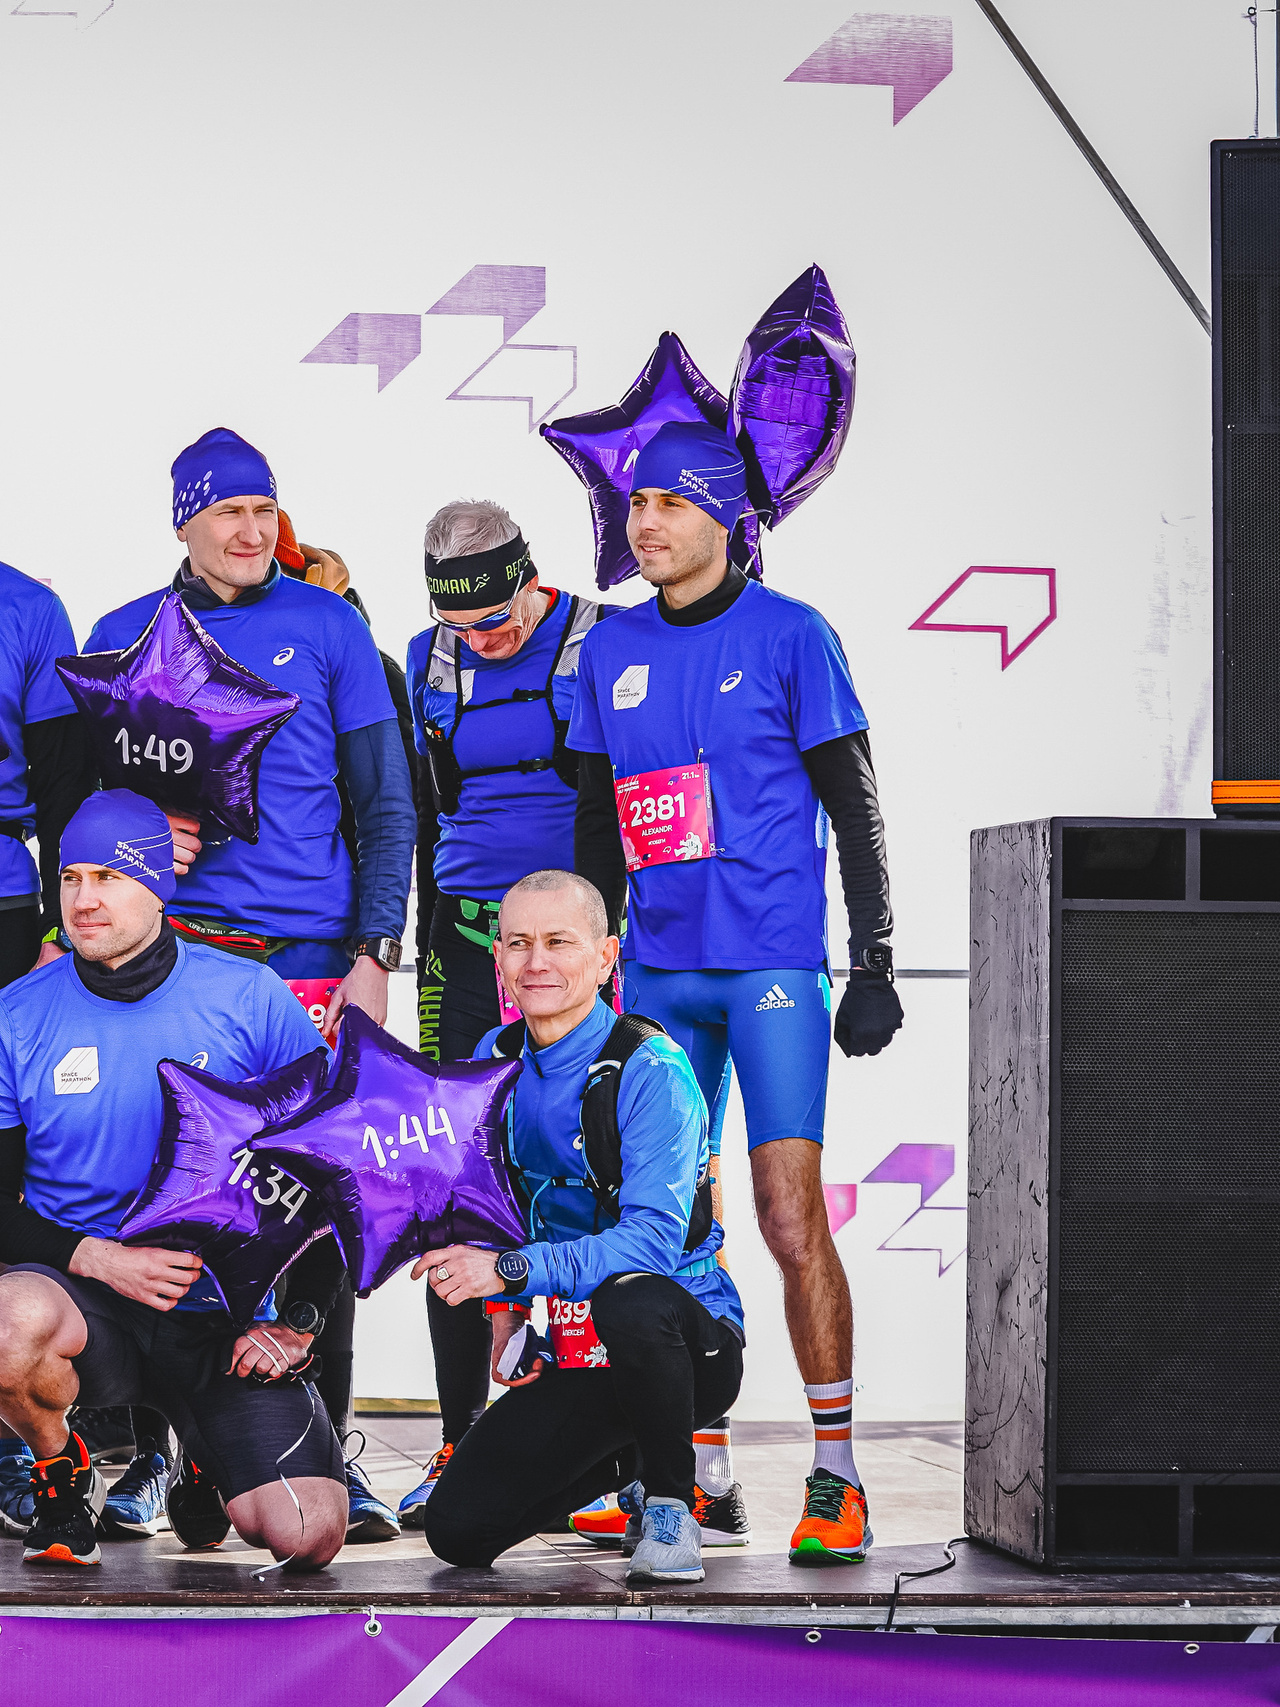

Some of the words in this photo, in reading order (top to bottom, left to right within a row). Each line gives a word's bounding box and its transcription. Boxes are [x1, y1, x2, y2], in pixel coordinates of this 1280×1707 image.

[678, 475, 723, 510] MARATHON
[681, 469, 710, 490] SPACE
[114, 727, 194, 774] 1:49
[629, 792, 686, 827] 2381
[642, 824, 673, 837] ALEXANDR
[114, 848, 160, 881] MARATHON
[117, 841, 145, 862] SPACE
[188, 922, 202, 932] LIFE
[755, 998, 796, 1013] adidas
[361, 1104, 458, 1169] 1:44
[227, 1146, 308, 1225] 1:34
[502, 1260, 524, 1273] 11:11
